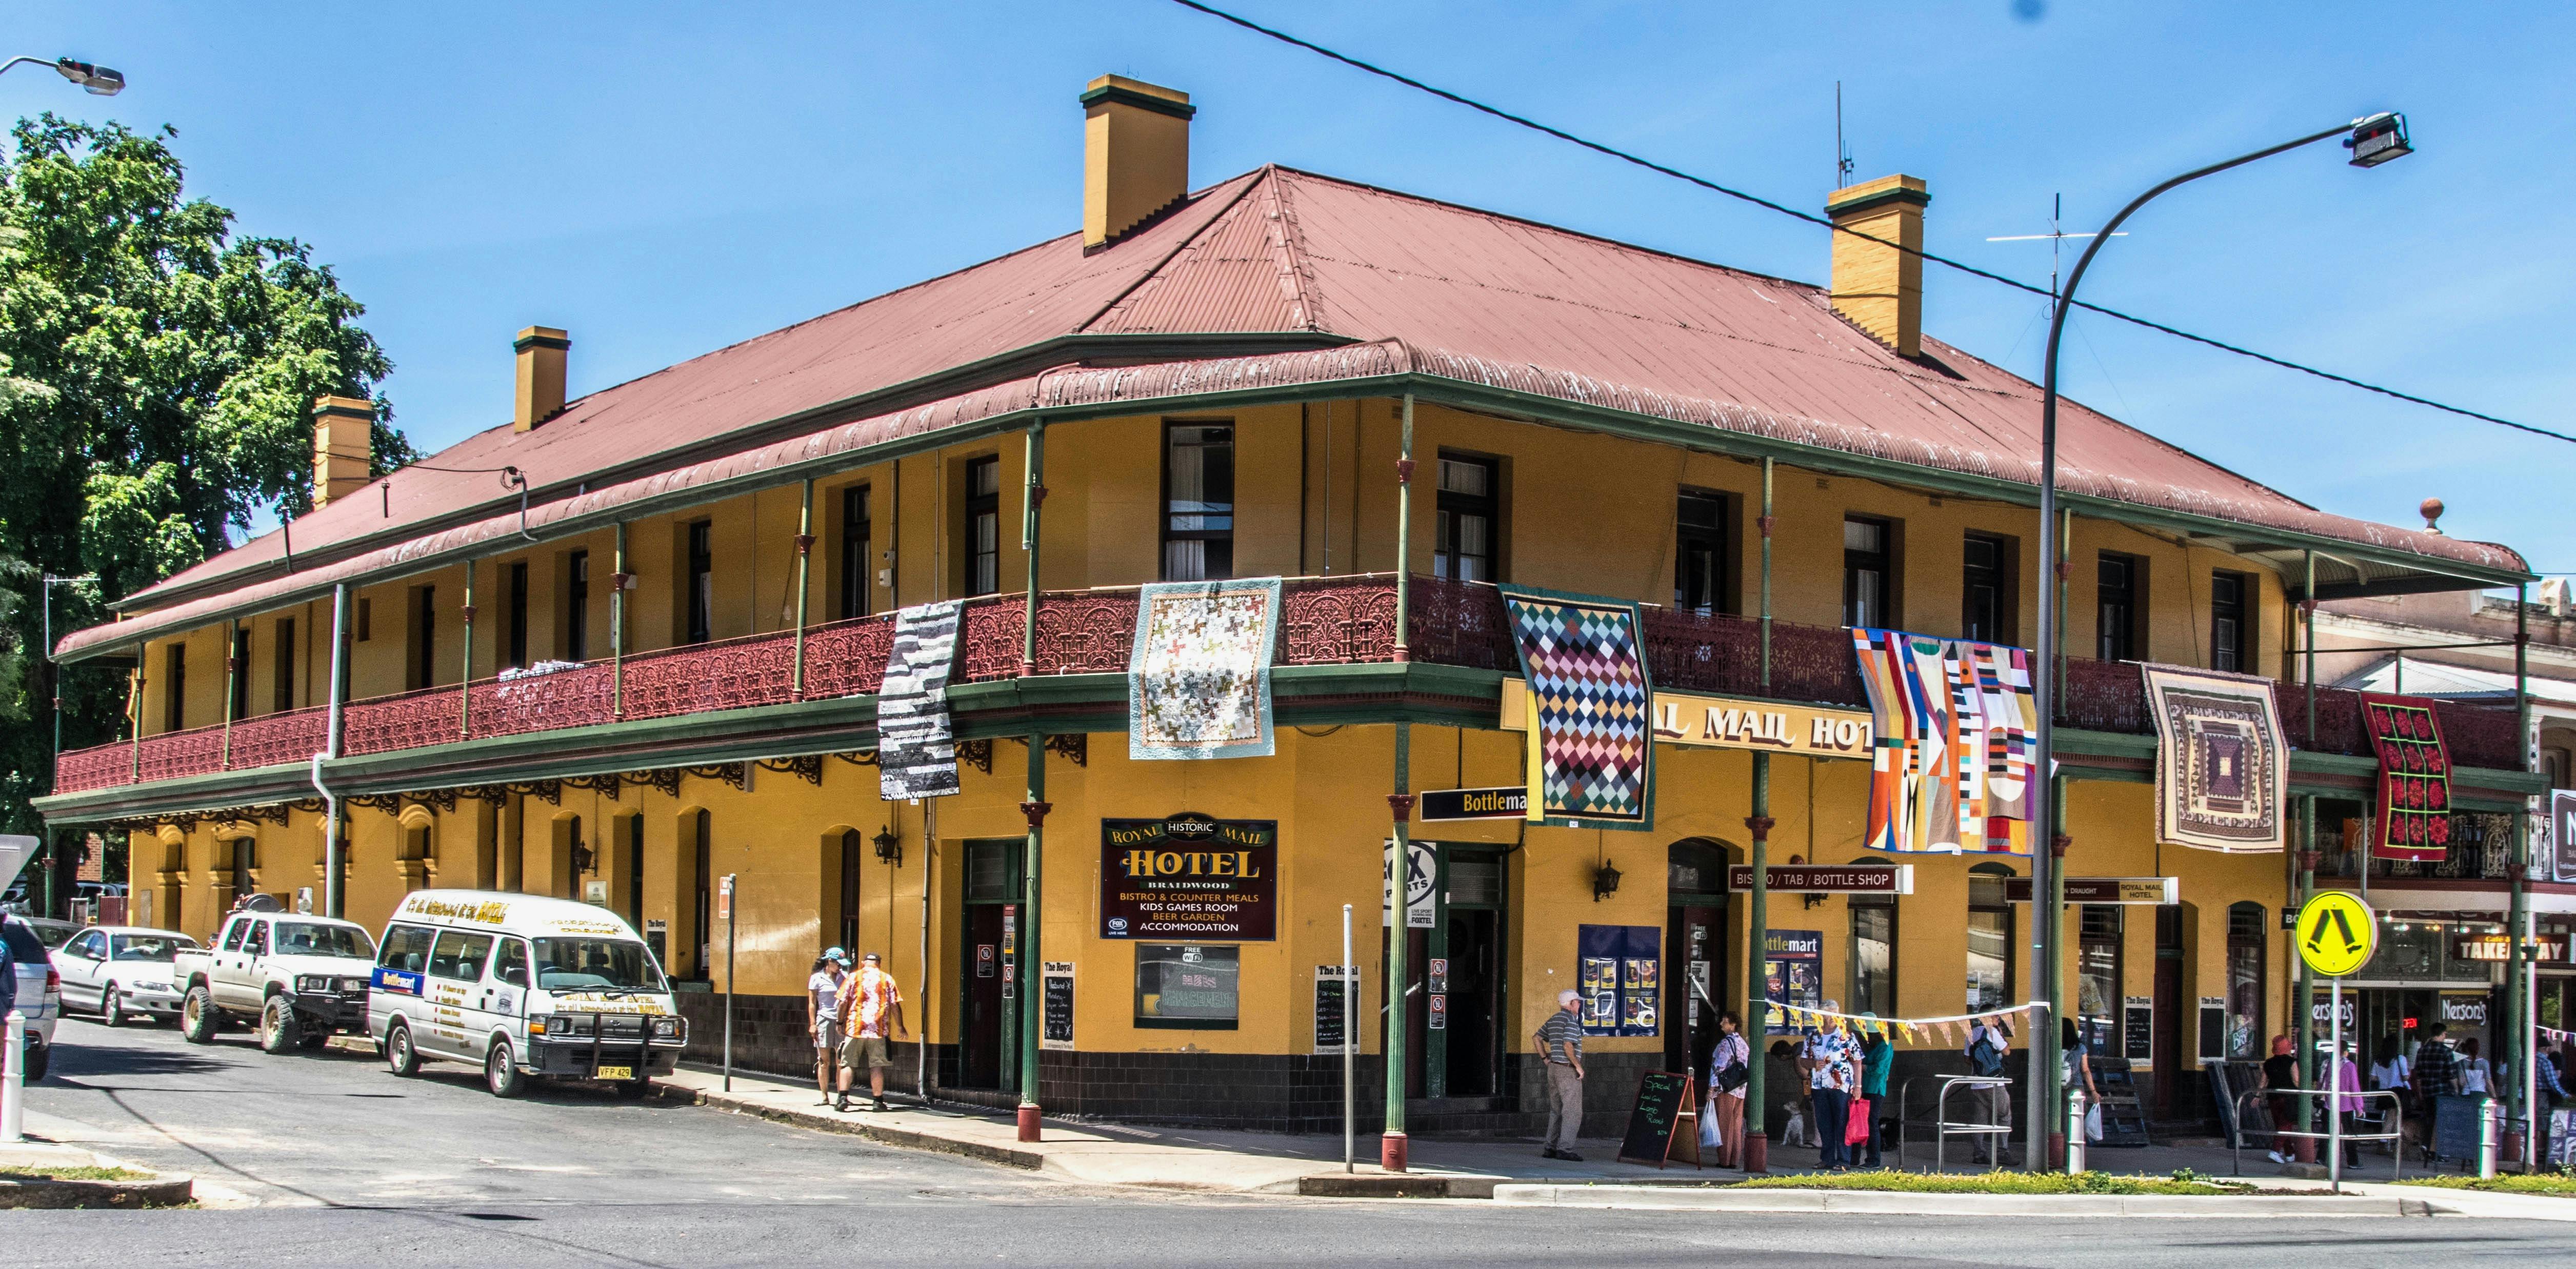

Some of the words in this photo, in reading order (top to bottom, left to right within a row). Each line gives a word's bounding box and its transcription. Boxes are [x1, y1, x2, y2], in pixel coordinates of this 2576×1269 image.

[1705, 706, 1797, 745] MAIL
[1168, 822, 1214, 832] HISTORIC
[1112, 826, 1161, 843] ROYAL
[1223, 827, 1265, 845] MAIL
[1121, 850, 1260, 878] HOTEL
[1737, 874, 1773, 885] BISO
[1784, 874, 1804, 885] TAB
[1814, 874, 1854, 885] BOTTLE
[1858, 874, 1889, 885] SHOP
[1148, 881, 1230, 889] BRAIDWOOD
[1120, 893, 1156, 901] BISTRO
[1159, 894, 1167, 902] &
[1170, 894, 1222, 902] COUNTER
[1226, 894, 1259, 903] MEALS
[1140, 903, 1163, 911] KIDS
[1167, 903, 1202, 912] GAMES
[1205, 903, 1238, 913] ROOM
[1153, 912, 1177, 921] BEER
[1181, 913, 1225, 921] GARDEN
[655, 920, 666, 928] Royal
[1140, 923, 1239, 932] ACCOMMODATION
[2460, 942, 2563, 960] TAKEAY
[1045, 962, 1055, 971] The
[1056, 962, 1072, 974] Royal
[1319, 966, 1334, 975] The
[1336, 966, 1359, 975] Roal
[383, 972, 415, 989] Bottlemart
[2136, 997, 2151, 1006] Royal
[2211, 997, 2224, 1006] Royal
[2442, 999, 2486, 1026] Nerson's
[600, 1068, 615, 1076] VFP
[617, 1068, 630, 1077] 429
[1645, 1076, 1670, 1092] Special
[1646, 1113, 1664, 1125] Roast
